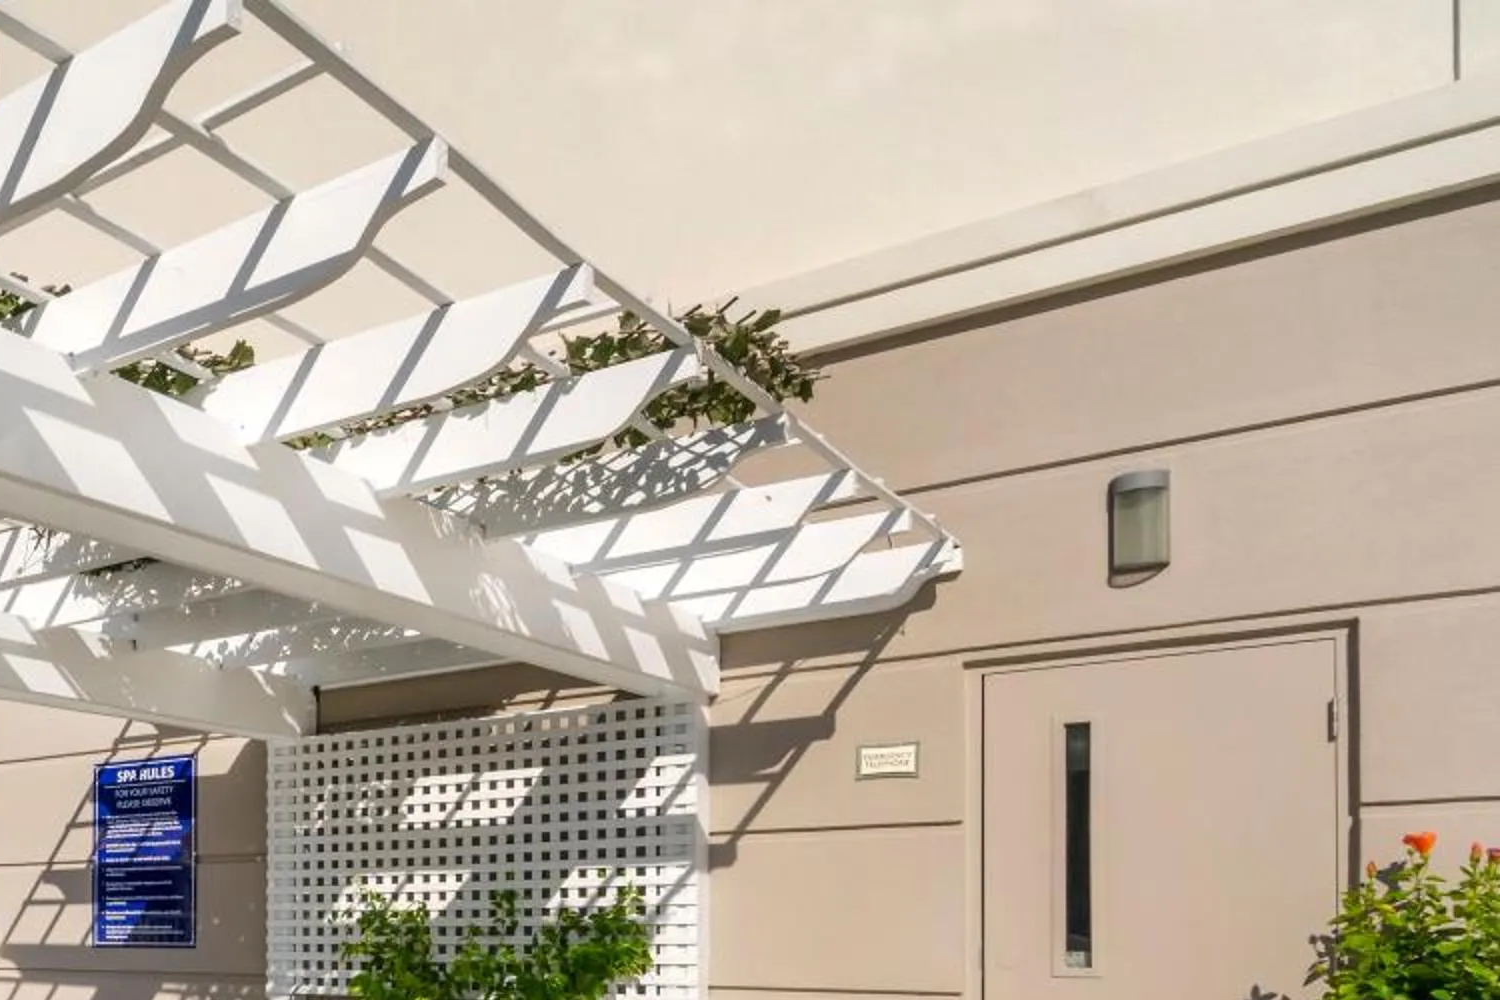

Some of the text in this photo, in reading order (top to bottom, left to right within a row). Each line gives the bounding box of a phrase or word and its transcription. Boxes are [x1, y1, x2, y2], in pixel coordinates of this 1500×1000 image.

[117, 765, 175, 783] SPA RULES
[130, 787, 148, 797] YOUR
